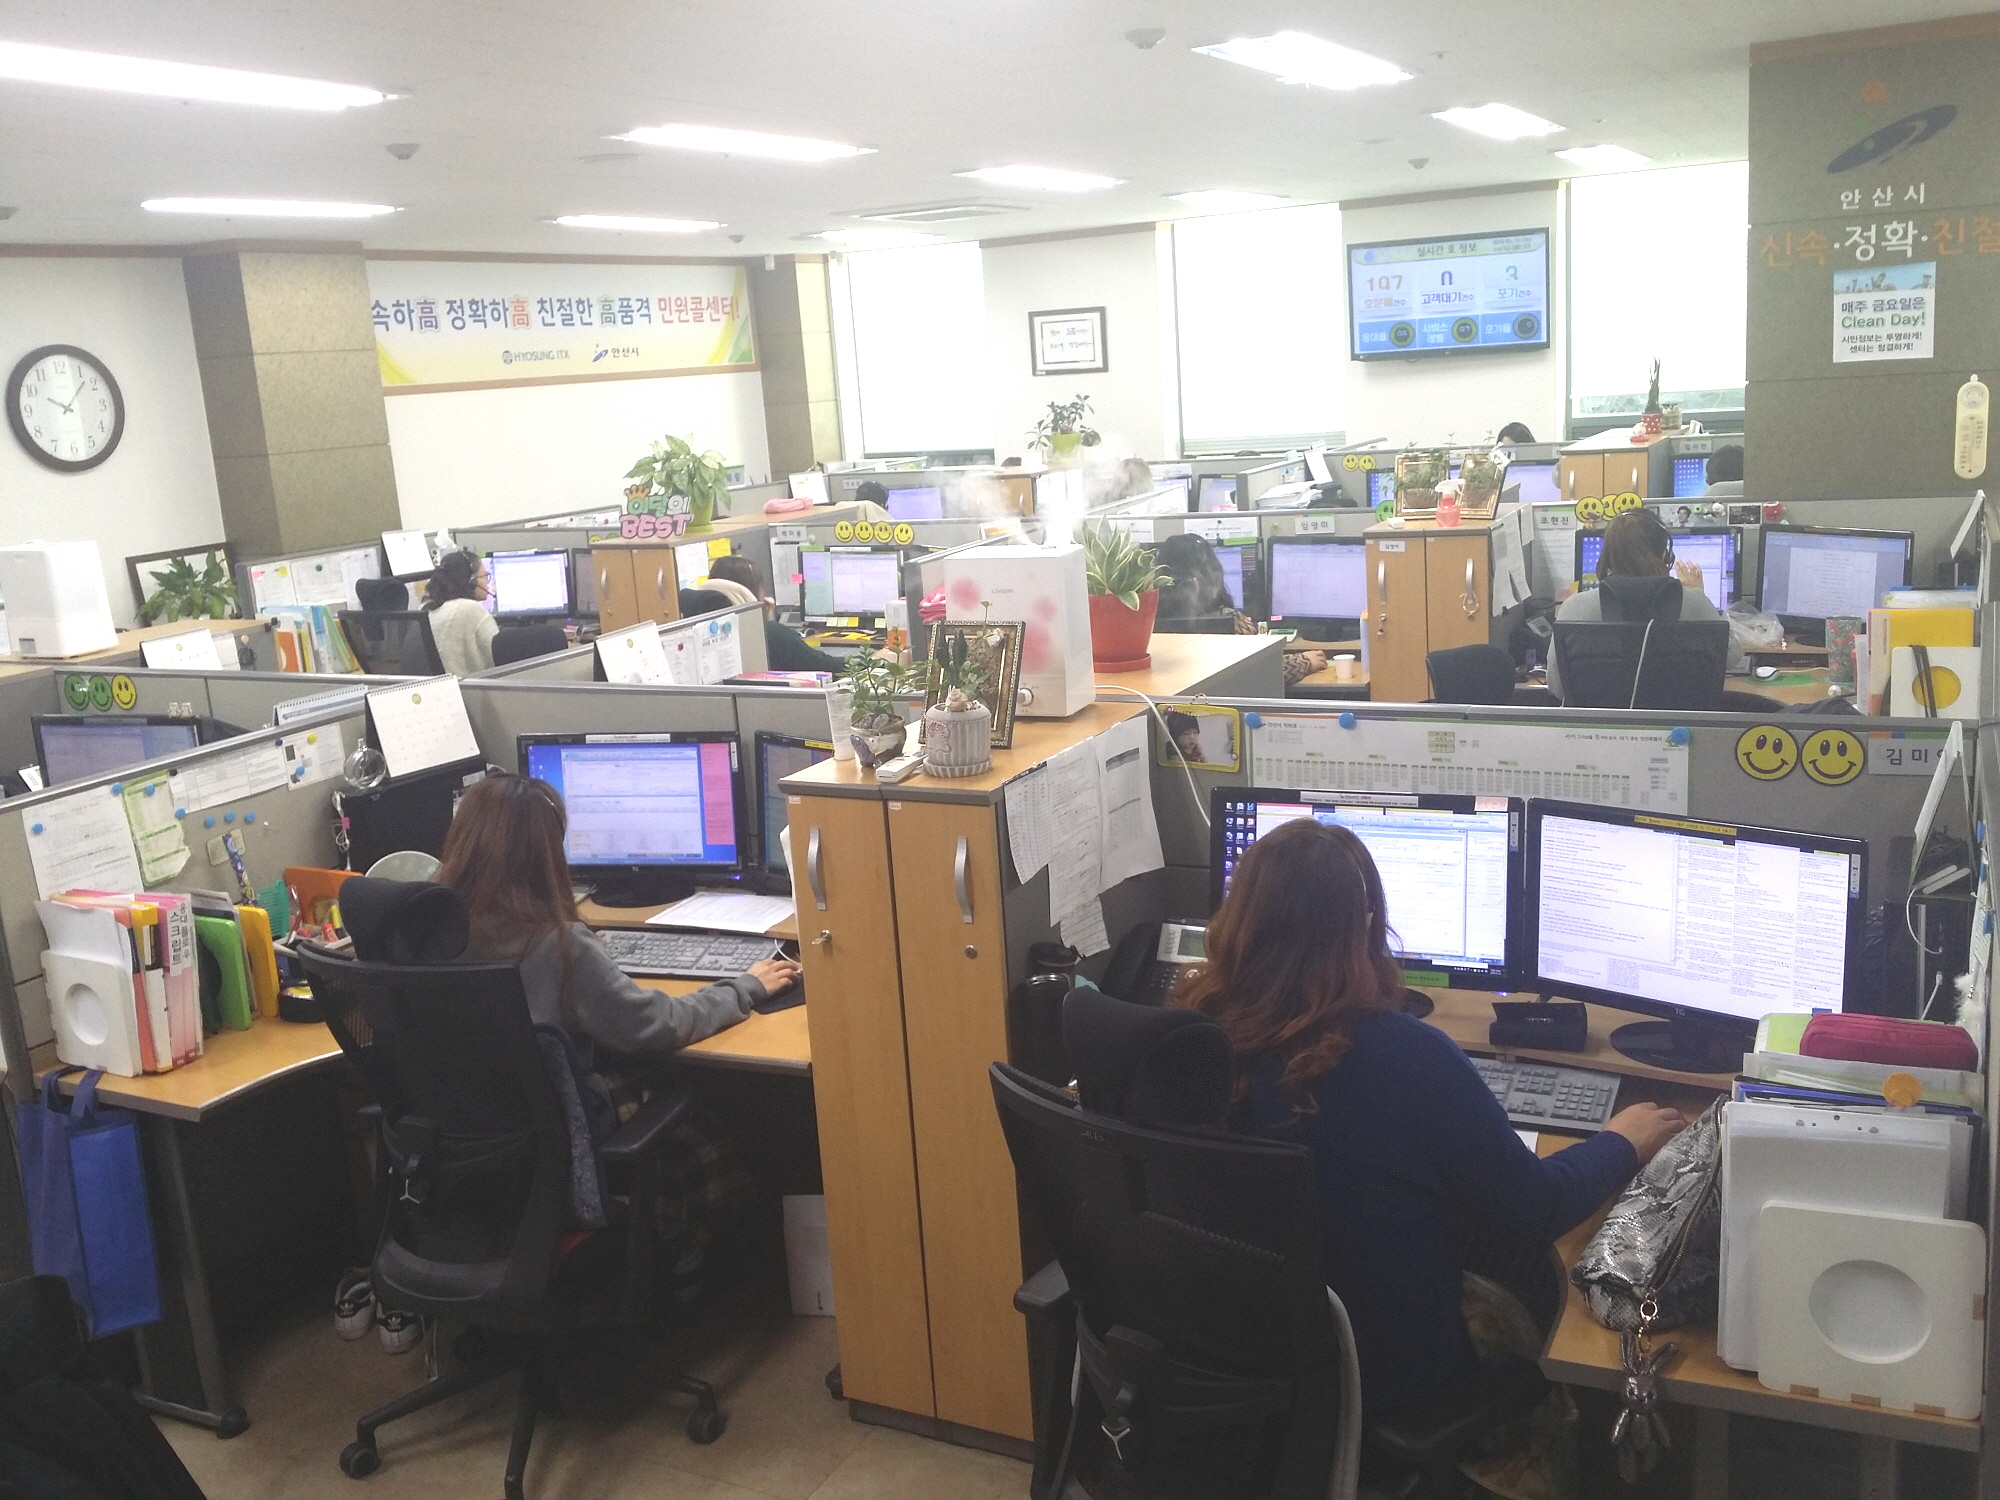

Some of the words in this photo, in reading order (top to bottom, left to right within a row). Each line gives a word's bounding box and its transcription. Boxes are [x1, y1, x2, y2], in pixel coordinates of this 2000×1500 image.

[1840, 182, 1925, 210] 안산시
[536, 296, 593, 327] 친절한
[657, 294, 741, 324] 민원콜센터!
[1841, 300, 1868, 314] 매주
[1872, 296, 1925, 312] 금요일은
[1841, 315, 1885, 328] Clean
[1890, 311, 1926, 327] Day!
[1841, 333, 1882, 343] 시민정보는
[1886, 331, 1922, 341] 투명하게!
[514, 349, 555, 362] HYOSUNG
[611, 346, 640, 358] 안산시
[1849, 344, 1874, 353] 센터는
[53, 360, 66, 374] 12
[36, 368, 46, 382] 11
[26, 383, 38, 398] 10
[89, 377, 98, 391] 2
[24, 404, 33, 418] 9
[99, 398, 107, 412] 3
[34, 425, 43, 439] 8
[50, 439, 58, 452] 7
[70, 442, 79, 456] 6
[88, 435, 96, 449] 5
[619, 513, 693, 539] BEST
